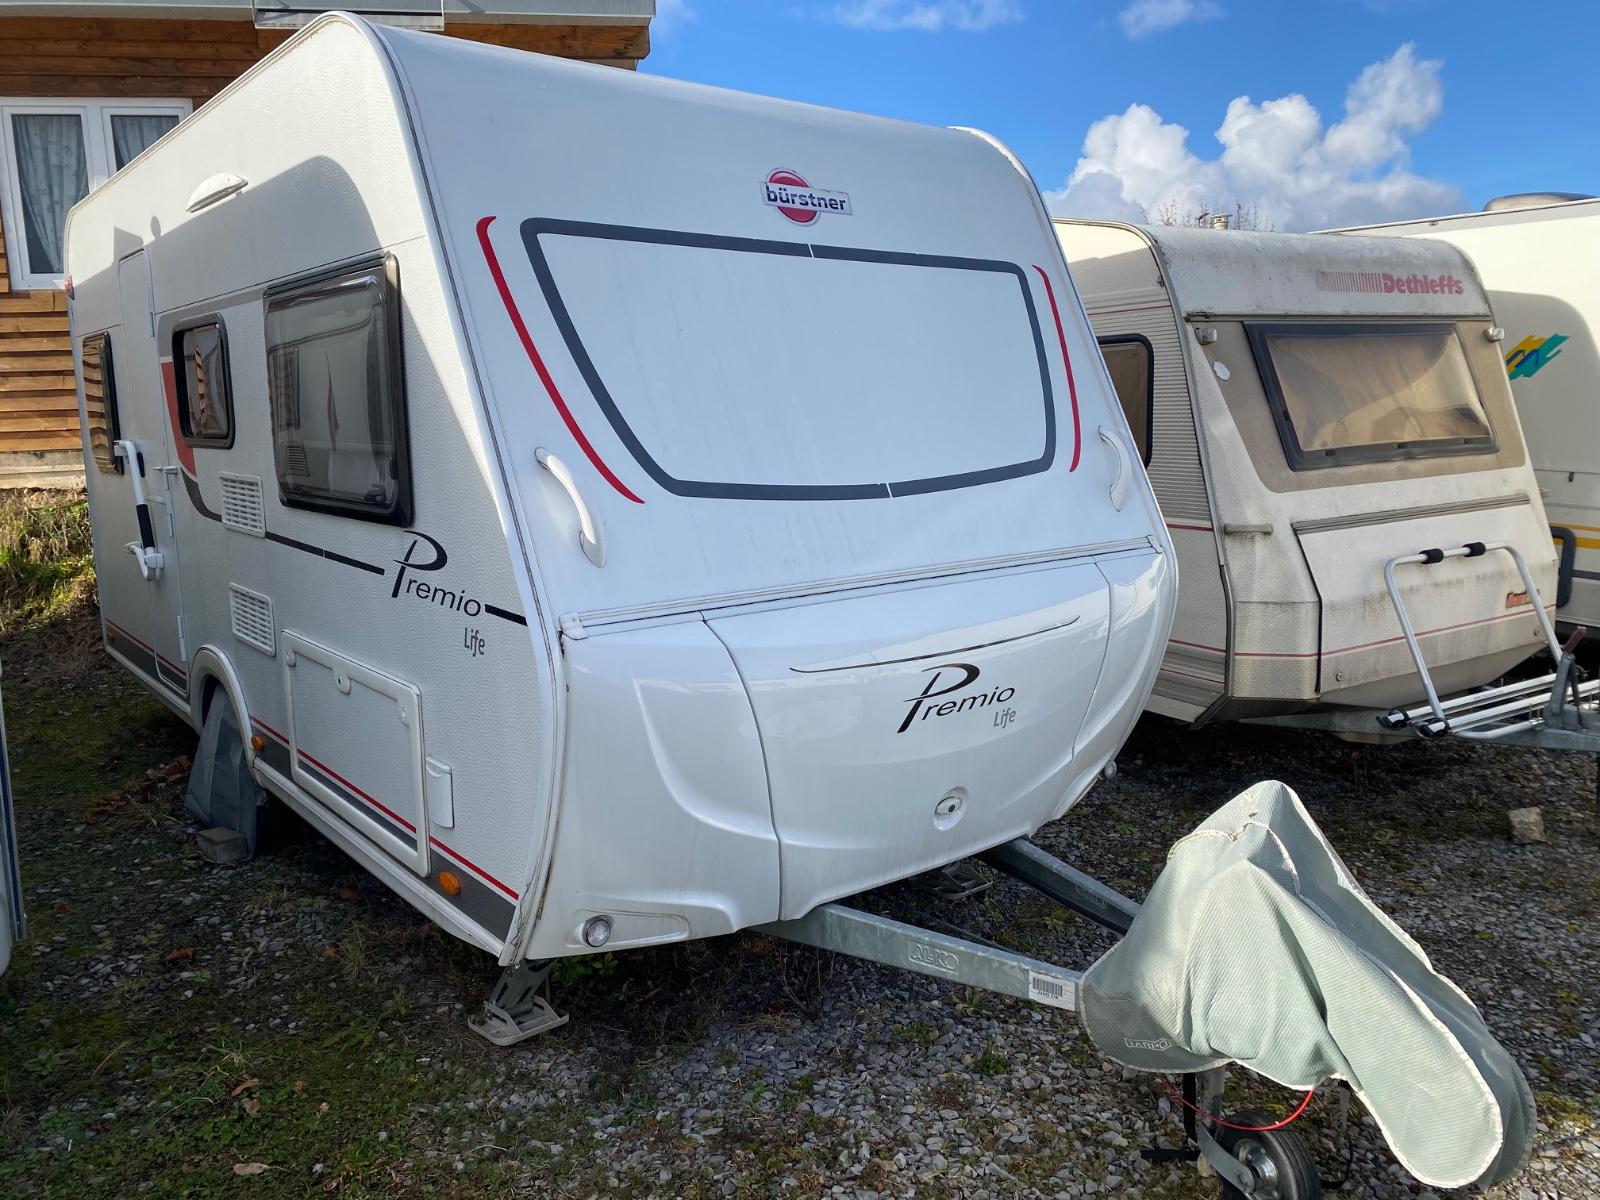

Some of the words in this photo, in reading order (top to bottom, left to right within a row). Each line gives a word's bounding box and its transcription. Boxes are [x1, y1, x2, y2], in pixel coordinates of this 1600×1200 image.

[766, 185, 846, 210] bürstner
[1382, 273, 1464, 295] Dethleffs
[391, 530, 482, 617] Premio
[463, 627, 486, 657] Life
[897, 663, 1016, 734] Premio
[993, 707, 1017, 728] Life
